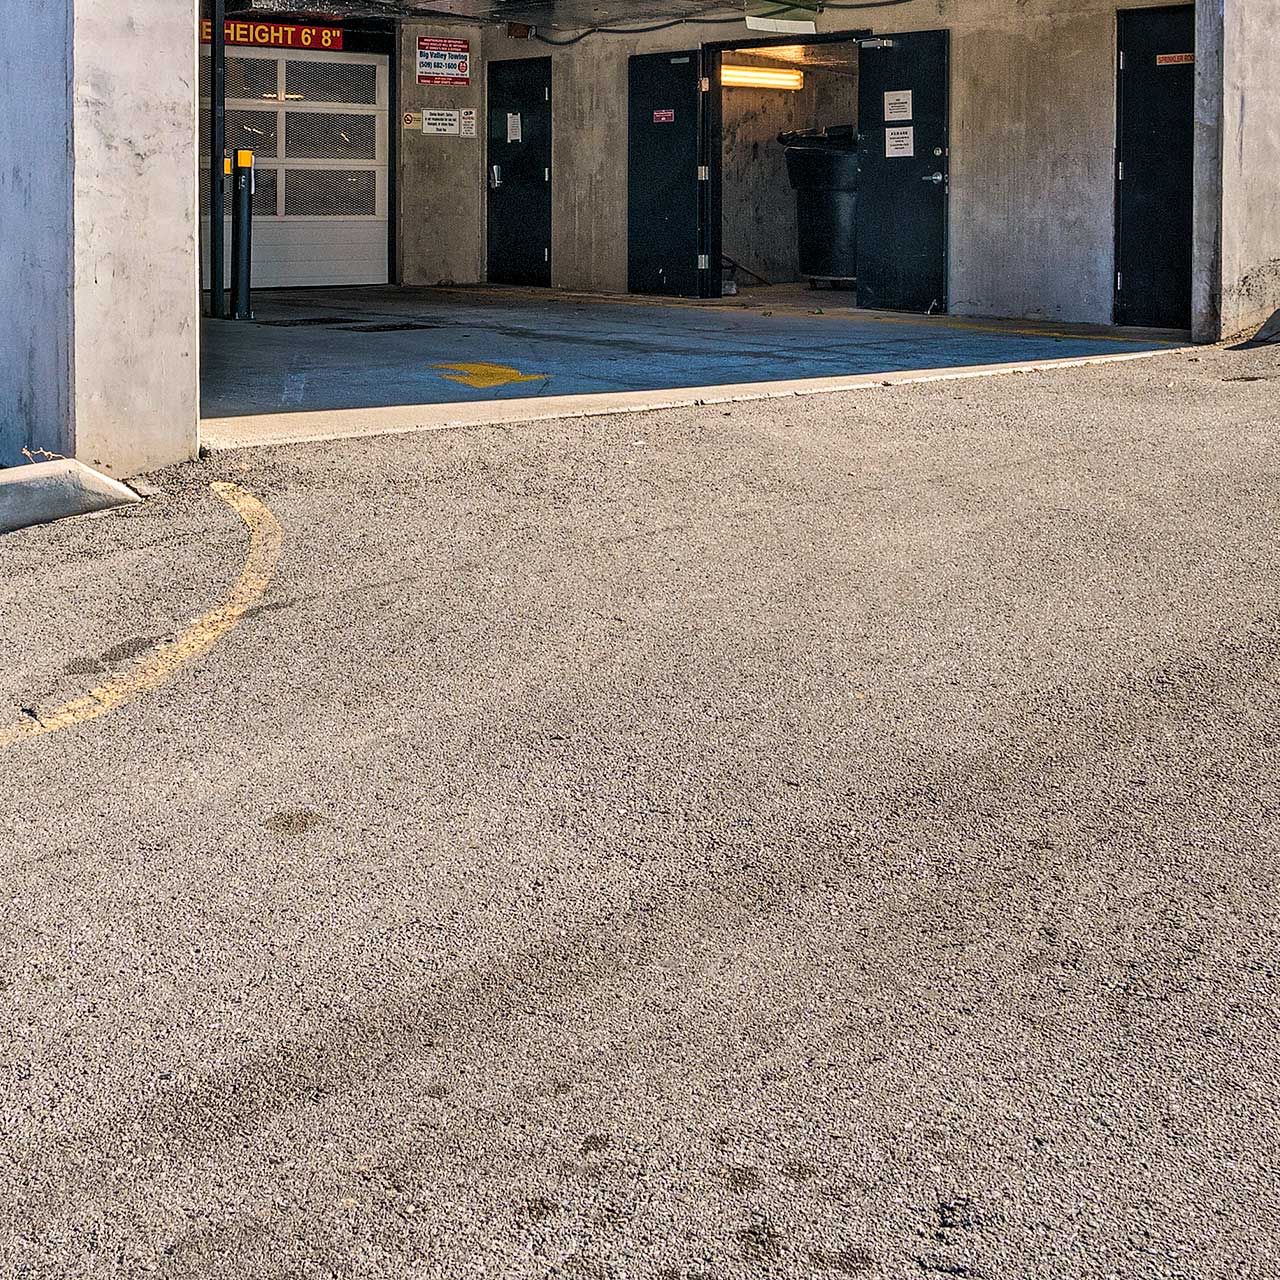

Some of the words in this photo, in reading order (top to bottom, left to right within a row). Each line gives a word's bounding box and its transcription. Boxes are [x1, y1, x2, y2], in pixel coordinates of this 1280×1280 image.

[224, 22, 296, 45] HEIGHT
[301, 28, 316, 46] 6'
[321, 29, 341, 47] 8"
[419, 51, 429, 59] Big
[430, 52, 447, 60] Valley
[448, 53, 468, 61] Towing
